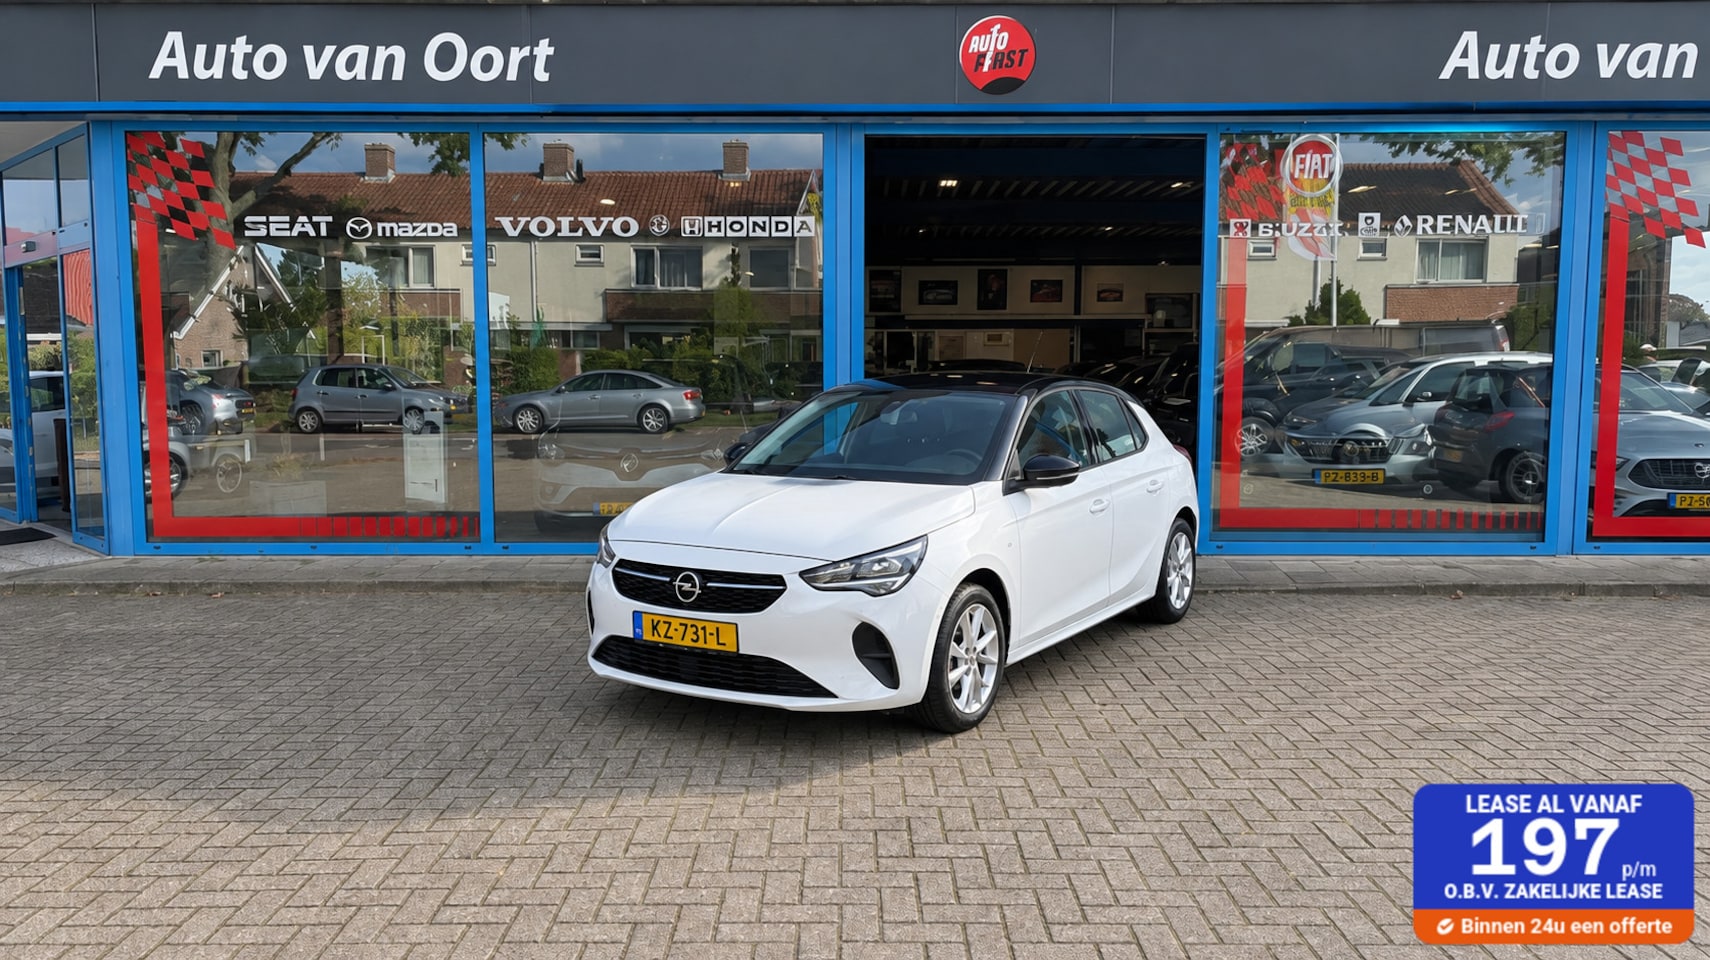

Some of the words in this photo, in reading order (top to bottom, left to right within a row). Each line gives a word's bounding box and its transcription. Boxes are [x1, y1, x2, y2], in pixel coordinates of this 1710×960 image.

[148, 31, 288, 81] Auto
[302, 44, 407, 81] van
[422, 32, 555, 82] Oort
[1438, 30, 1581, 80] Auto
[1596, 43, 1699, 80] van
[1294, 152, 1333, 179] FIAT
[244, 216, 333, 237] SEAT
[377, 221, 458, 237] mazda
[495, 216, 639, 237] VOLVO
[704, 216, 815, 237] HONDA
[651, 618, 727, 647] KZ-731-L
